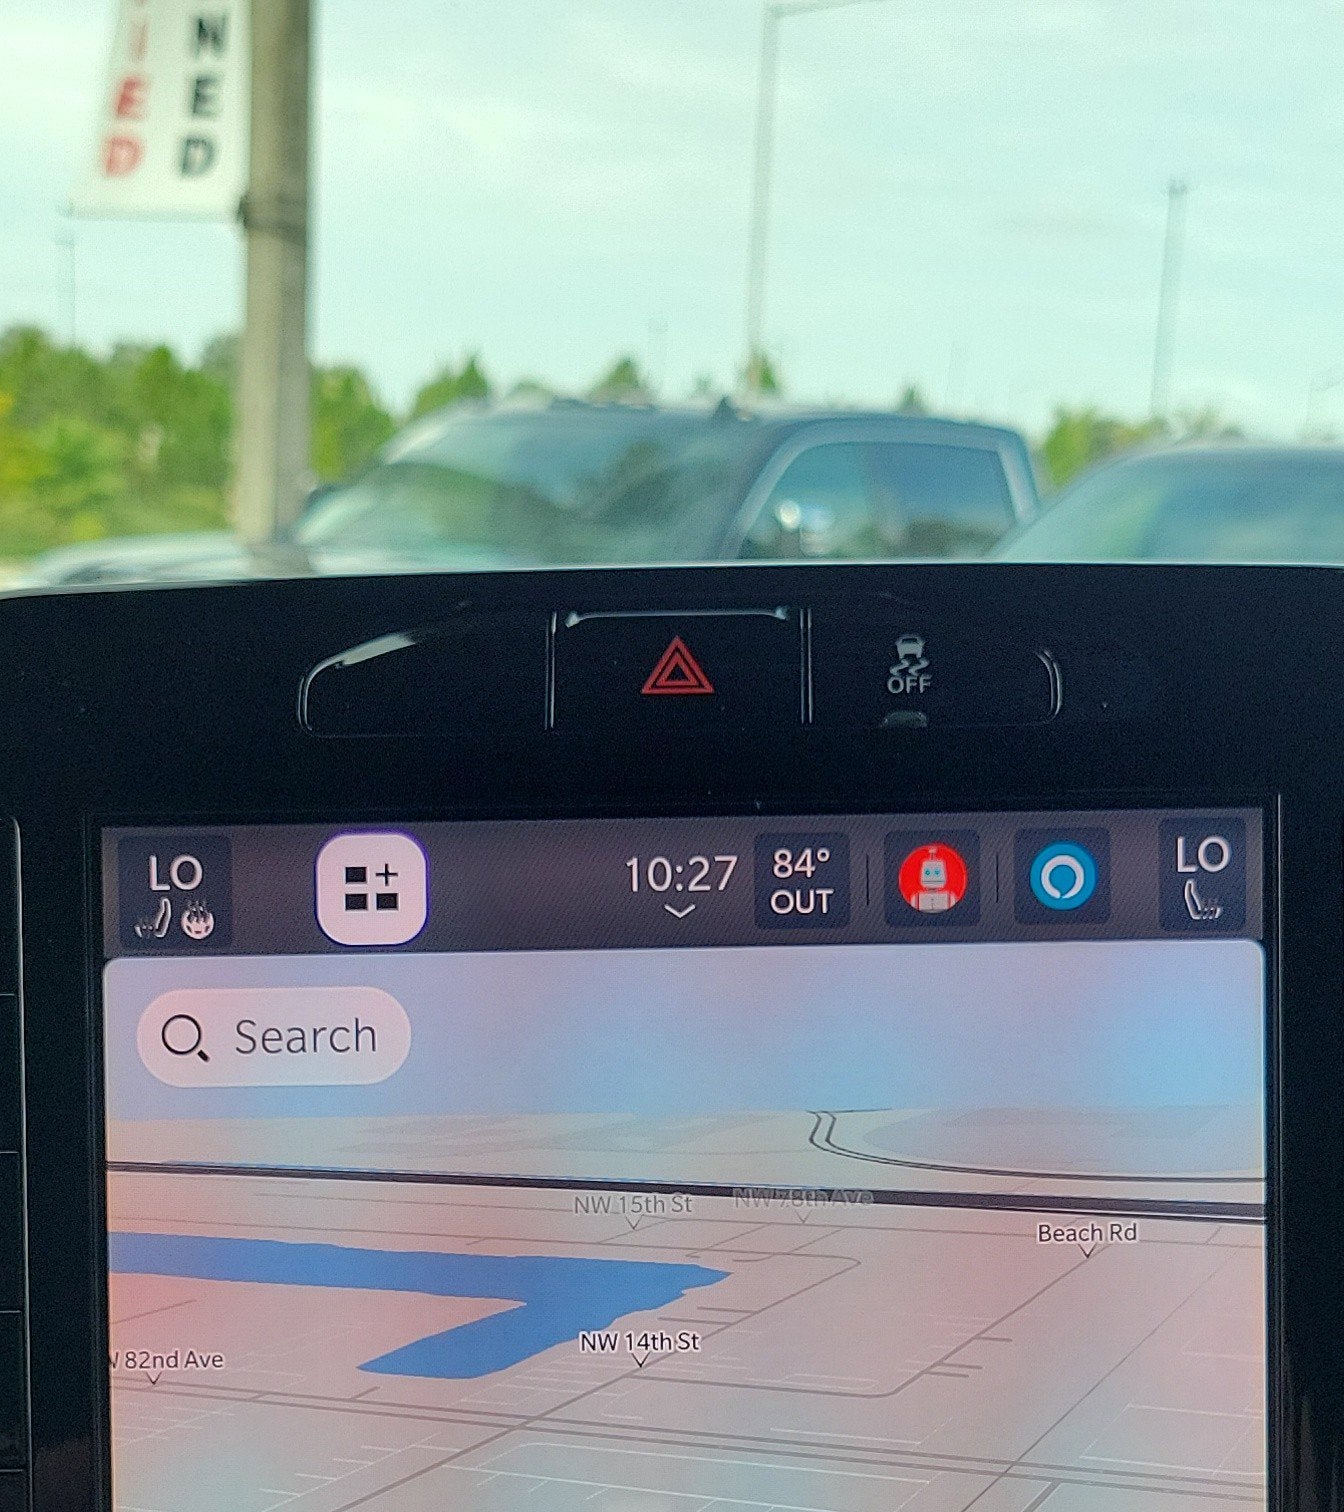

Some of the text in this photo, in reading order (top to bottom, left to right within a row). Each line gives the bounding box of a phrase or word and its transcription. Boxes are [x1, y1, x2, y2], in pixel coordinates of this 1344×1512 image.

[887, 676, 932, 694] OFF
[772, 848, 831, 880] 84°
[1176, 836, 1231, 874] LO
[149, 854, 203, 891] LO
[625, 855, 738, 893] 10:27
[769, 888, 834, 914] OUT
[235, 1017, 378, 1055] Search
[574, 1195, 693, 1214] NW 15th St
[1038, 1223, 1137, 1242] Beach Rd
[581, 1332, 699, 1351] NW 14th St
[125, 1350, 178, 1369] 82nd
[184, 1350, 224, 1368] Ave
